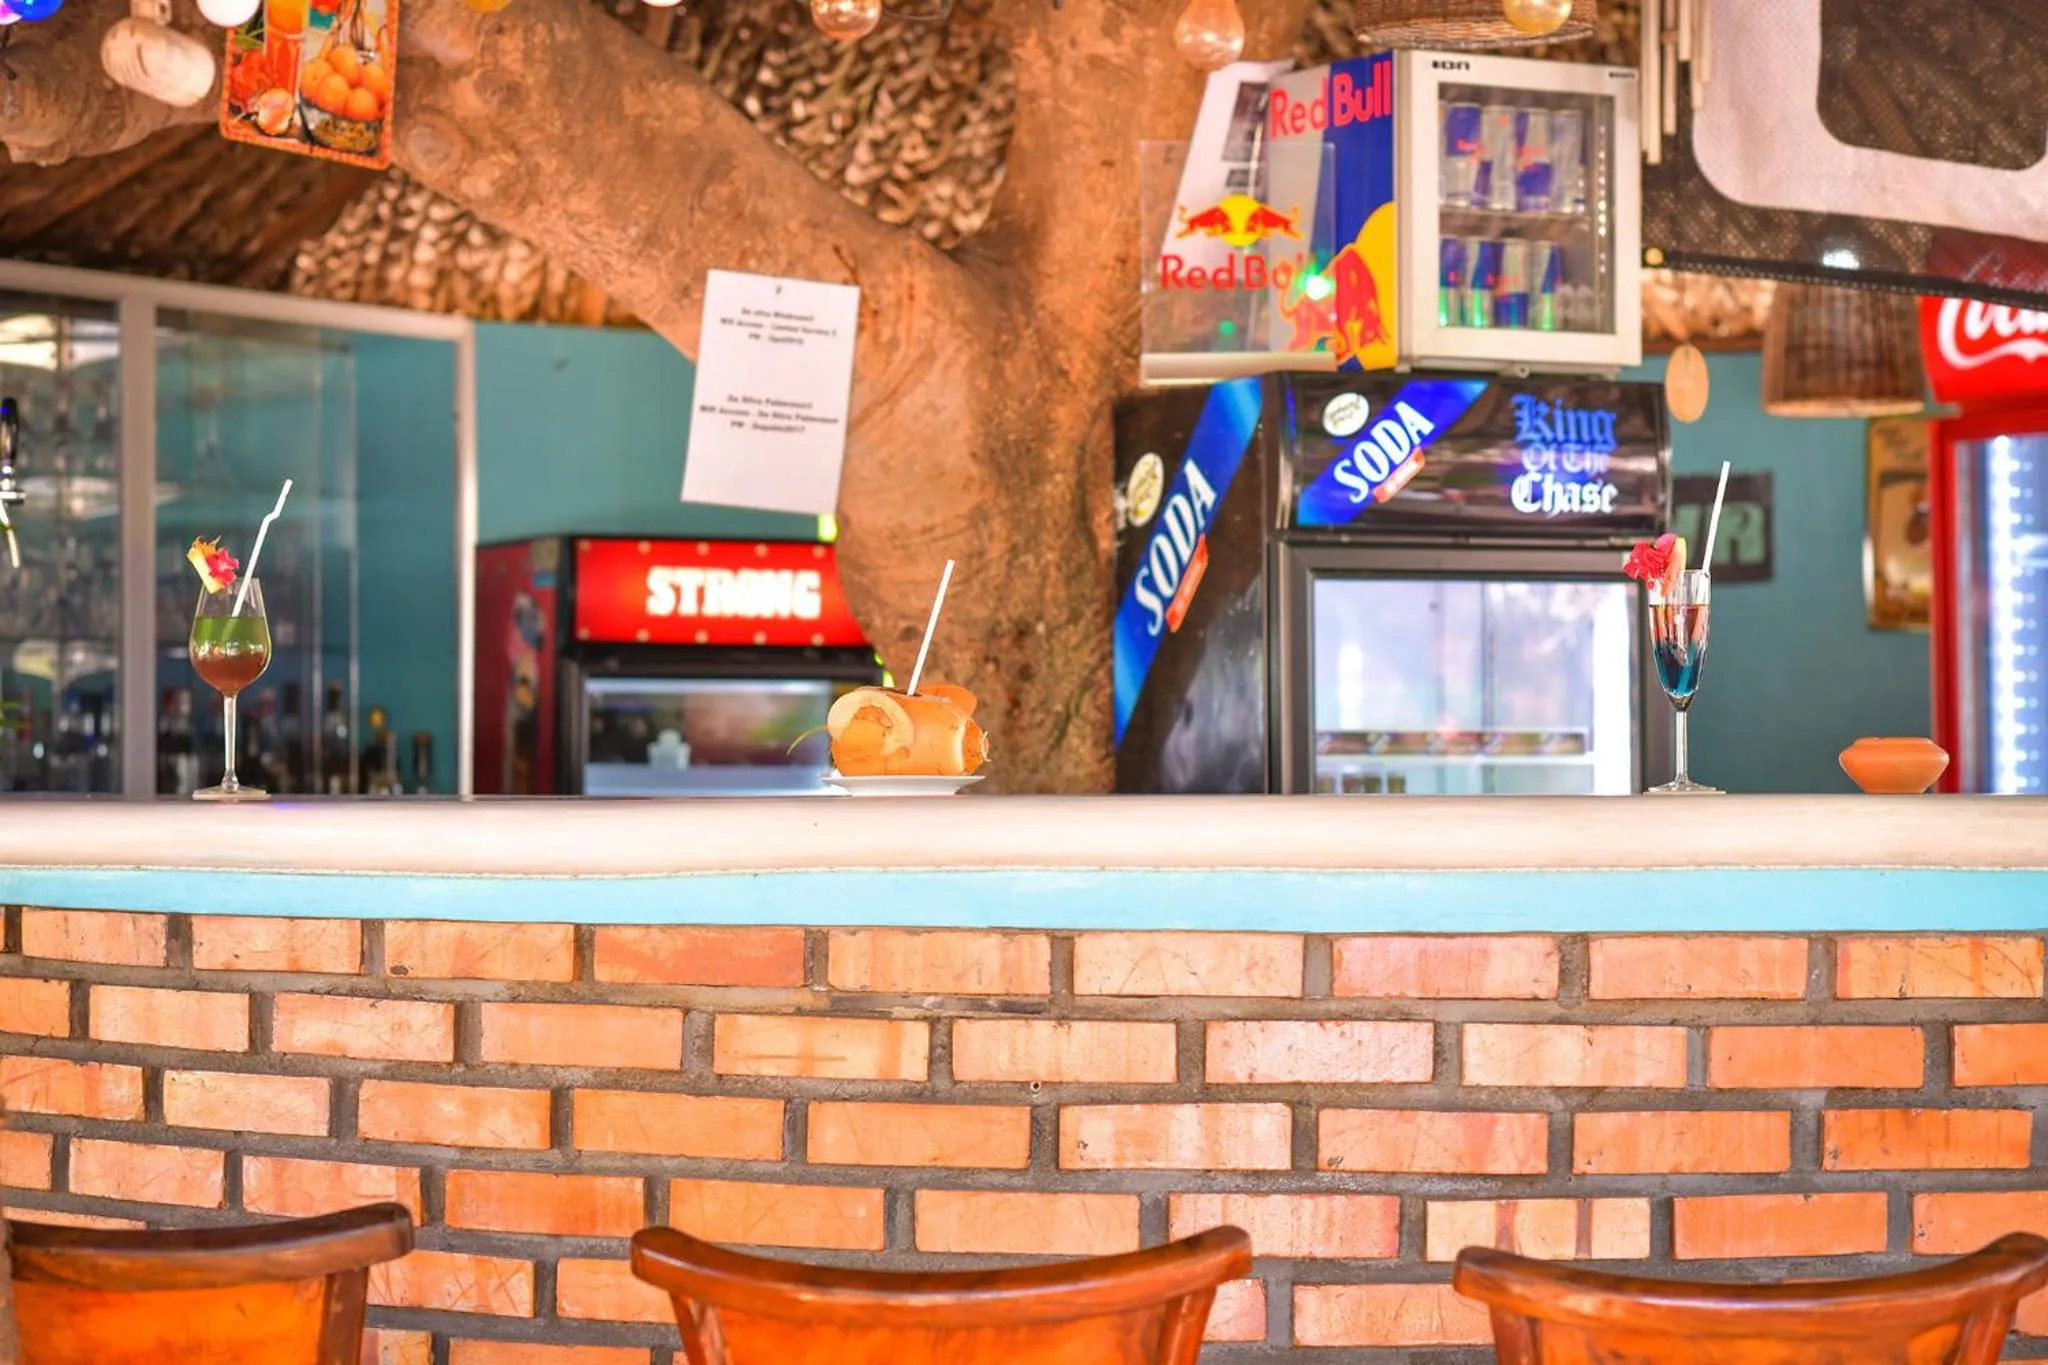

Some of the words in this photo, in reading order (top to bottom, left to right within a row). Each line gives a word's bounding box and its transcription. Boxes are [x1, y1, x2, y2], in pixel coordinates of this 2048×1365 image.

[1269, 76, 1329, 140] Red
[1332, 59, 1391, 127] Bull
[1160, 252, 1235, 290] Red
[1333, 400, 1436, 503] SODA
[1511, 393, 1617, 452] King
[1511, 472, 1618, 518] Chase
[1134, 458, 1218, 637] SODA
[645, 565, 822, 620] STRONG
